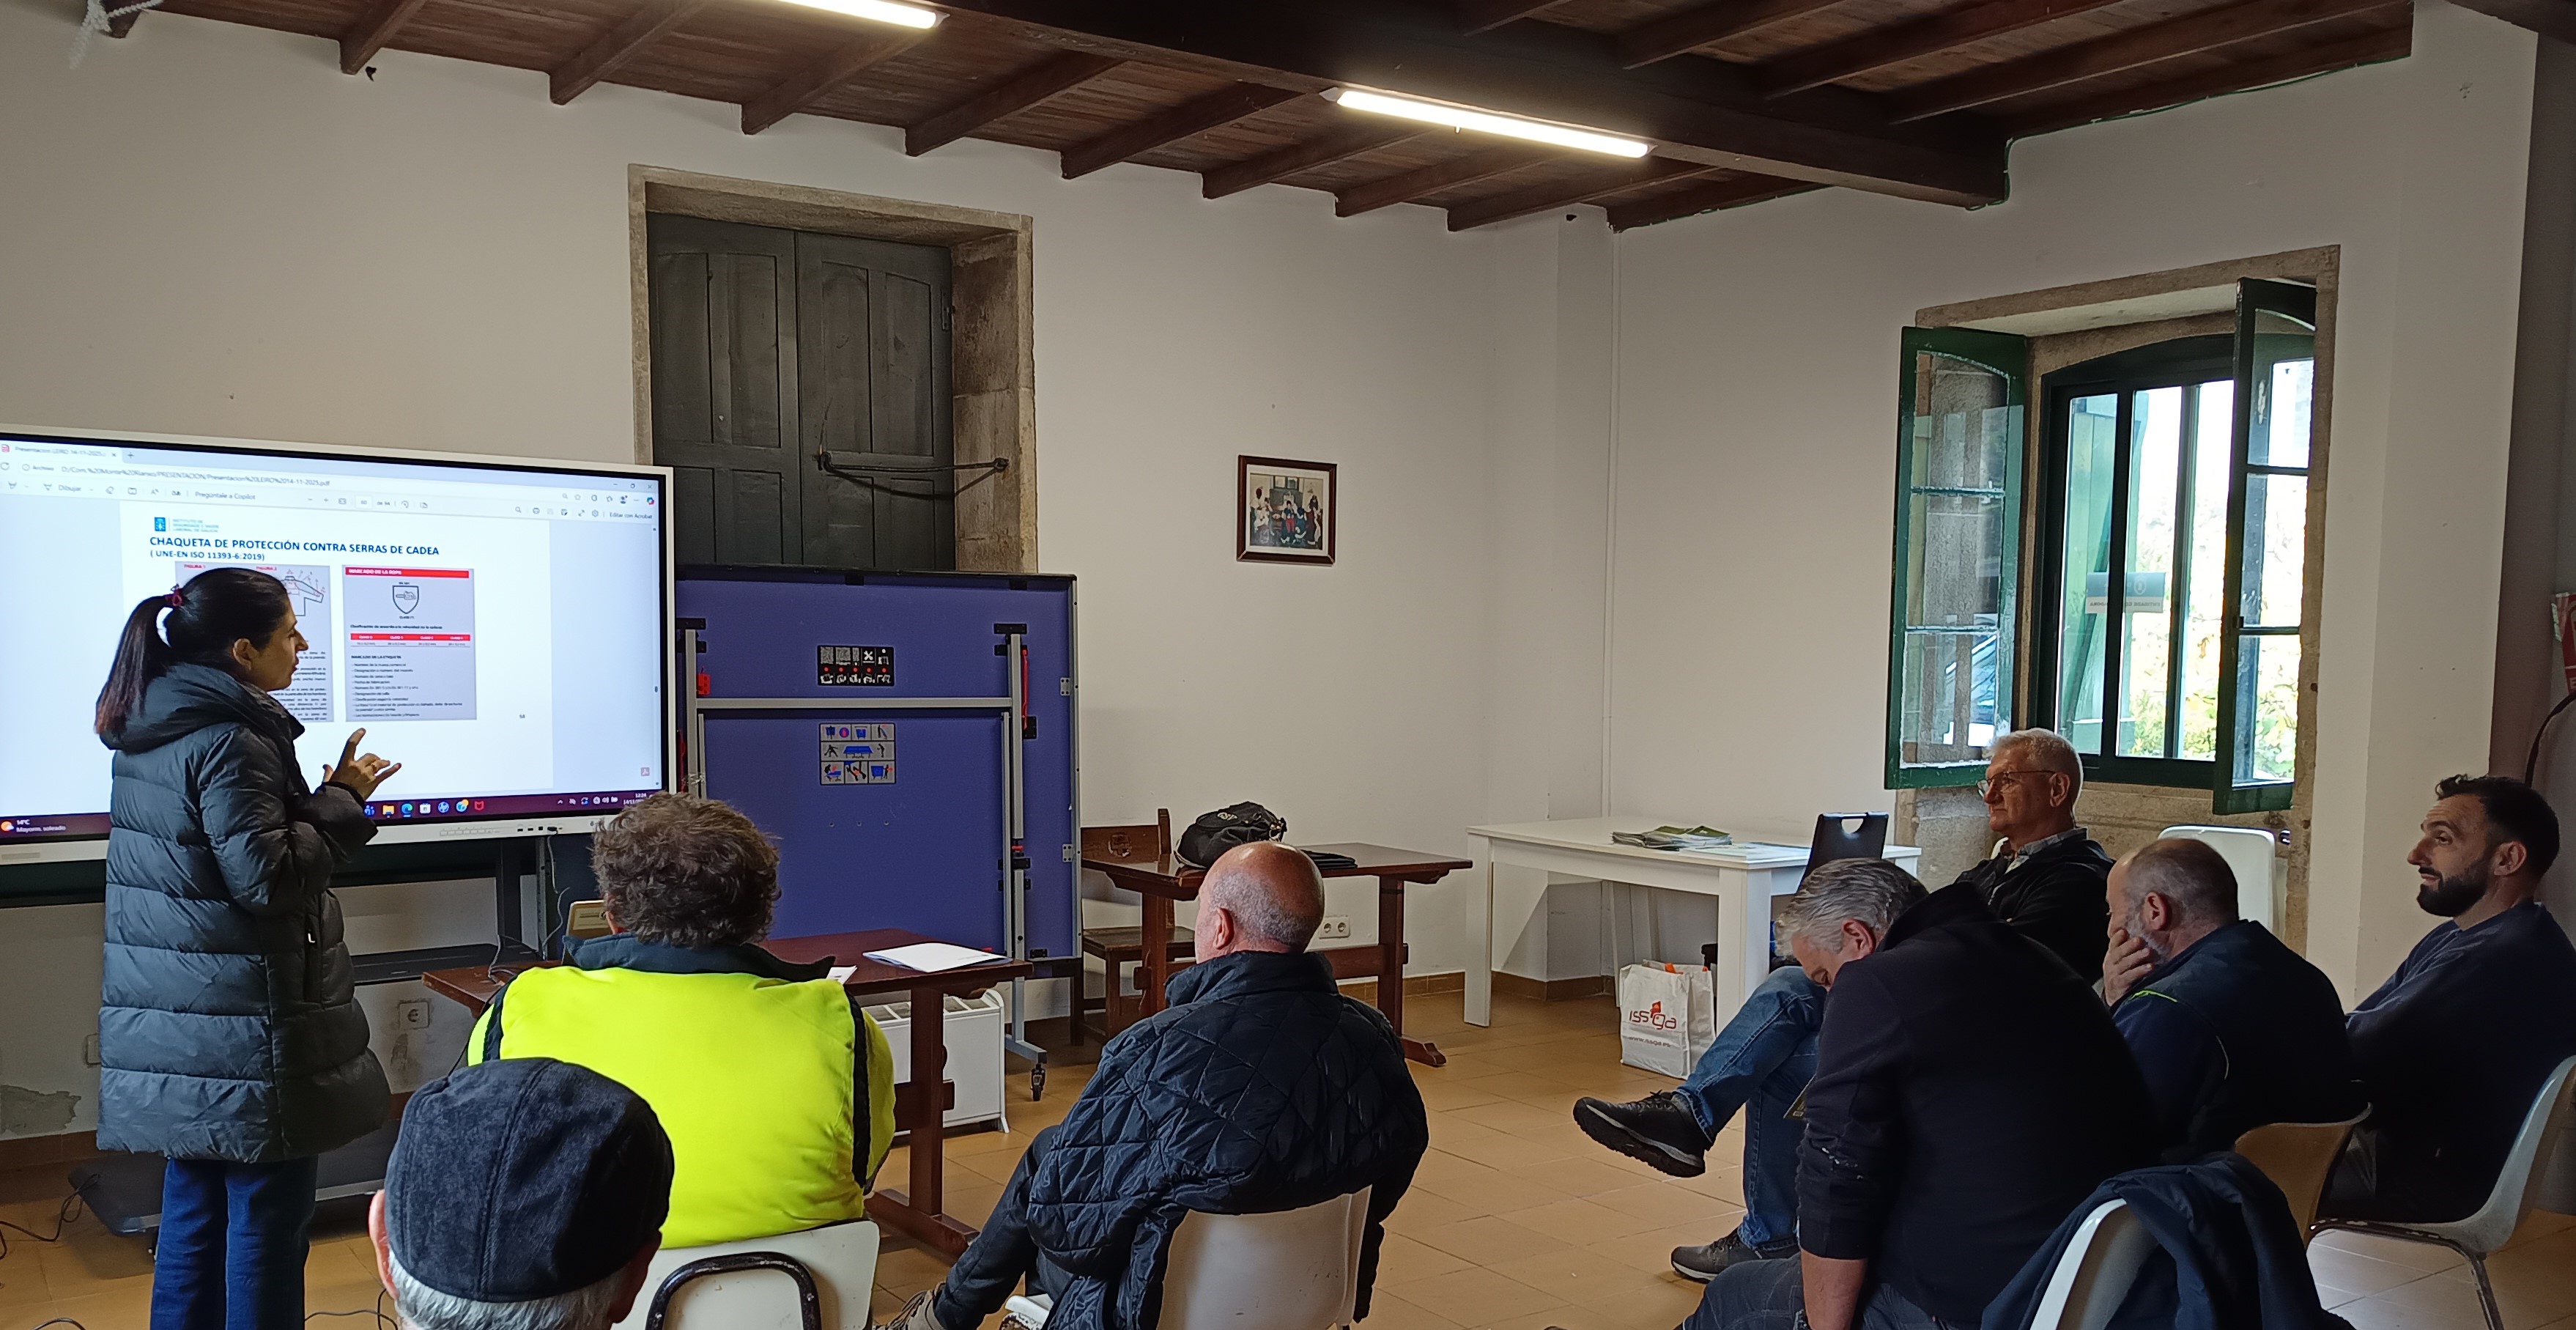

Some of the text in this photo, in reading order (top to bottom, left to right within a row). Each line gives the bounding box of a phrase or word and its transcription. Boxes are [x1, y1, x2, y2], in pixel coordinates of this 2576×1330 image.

[149, 536, 440, 555] CHAQUETA DE PROTECCIÓN CONTRA SERRAS DE CADEA
[208, 553, 264, 561] 11393-6:2019)
